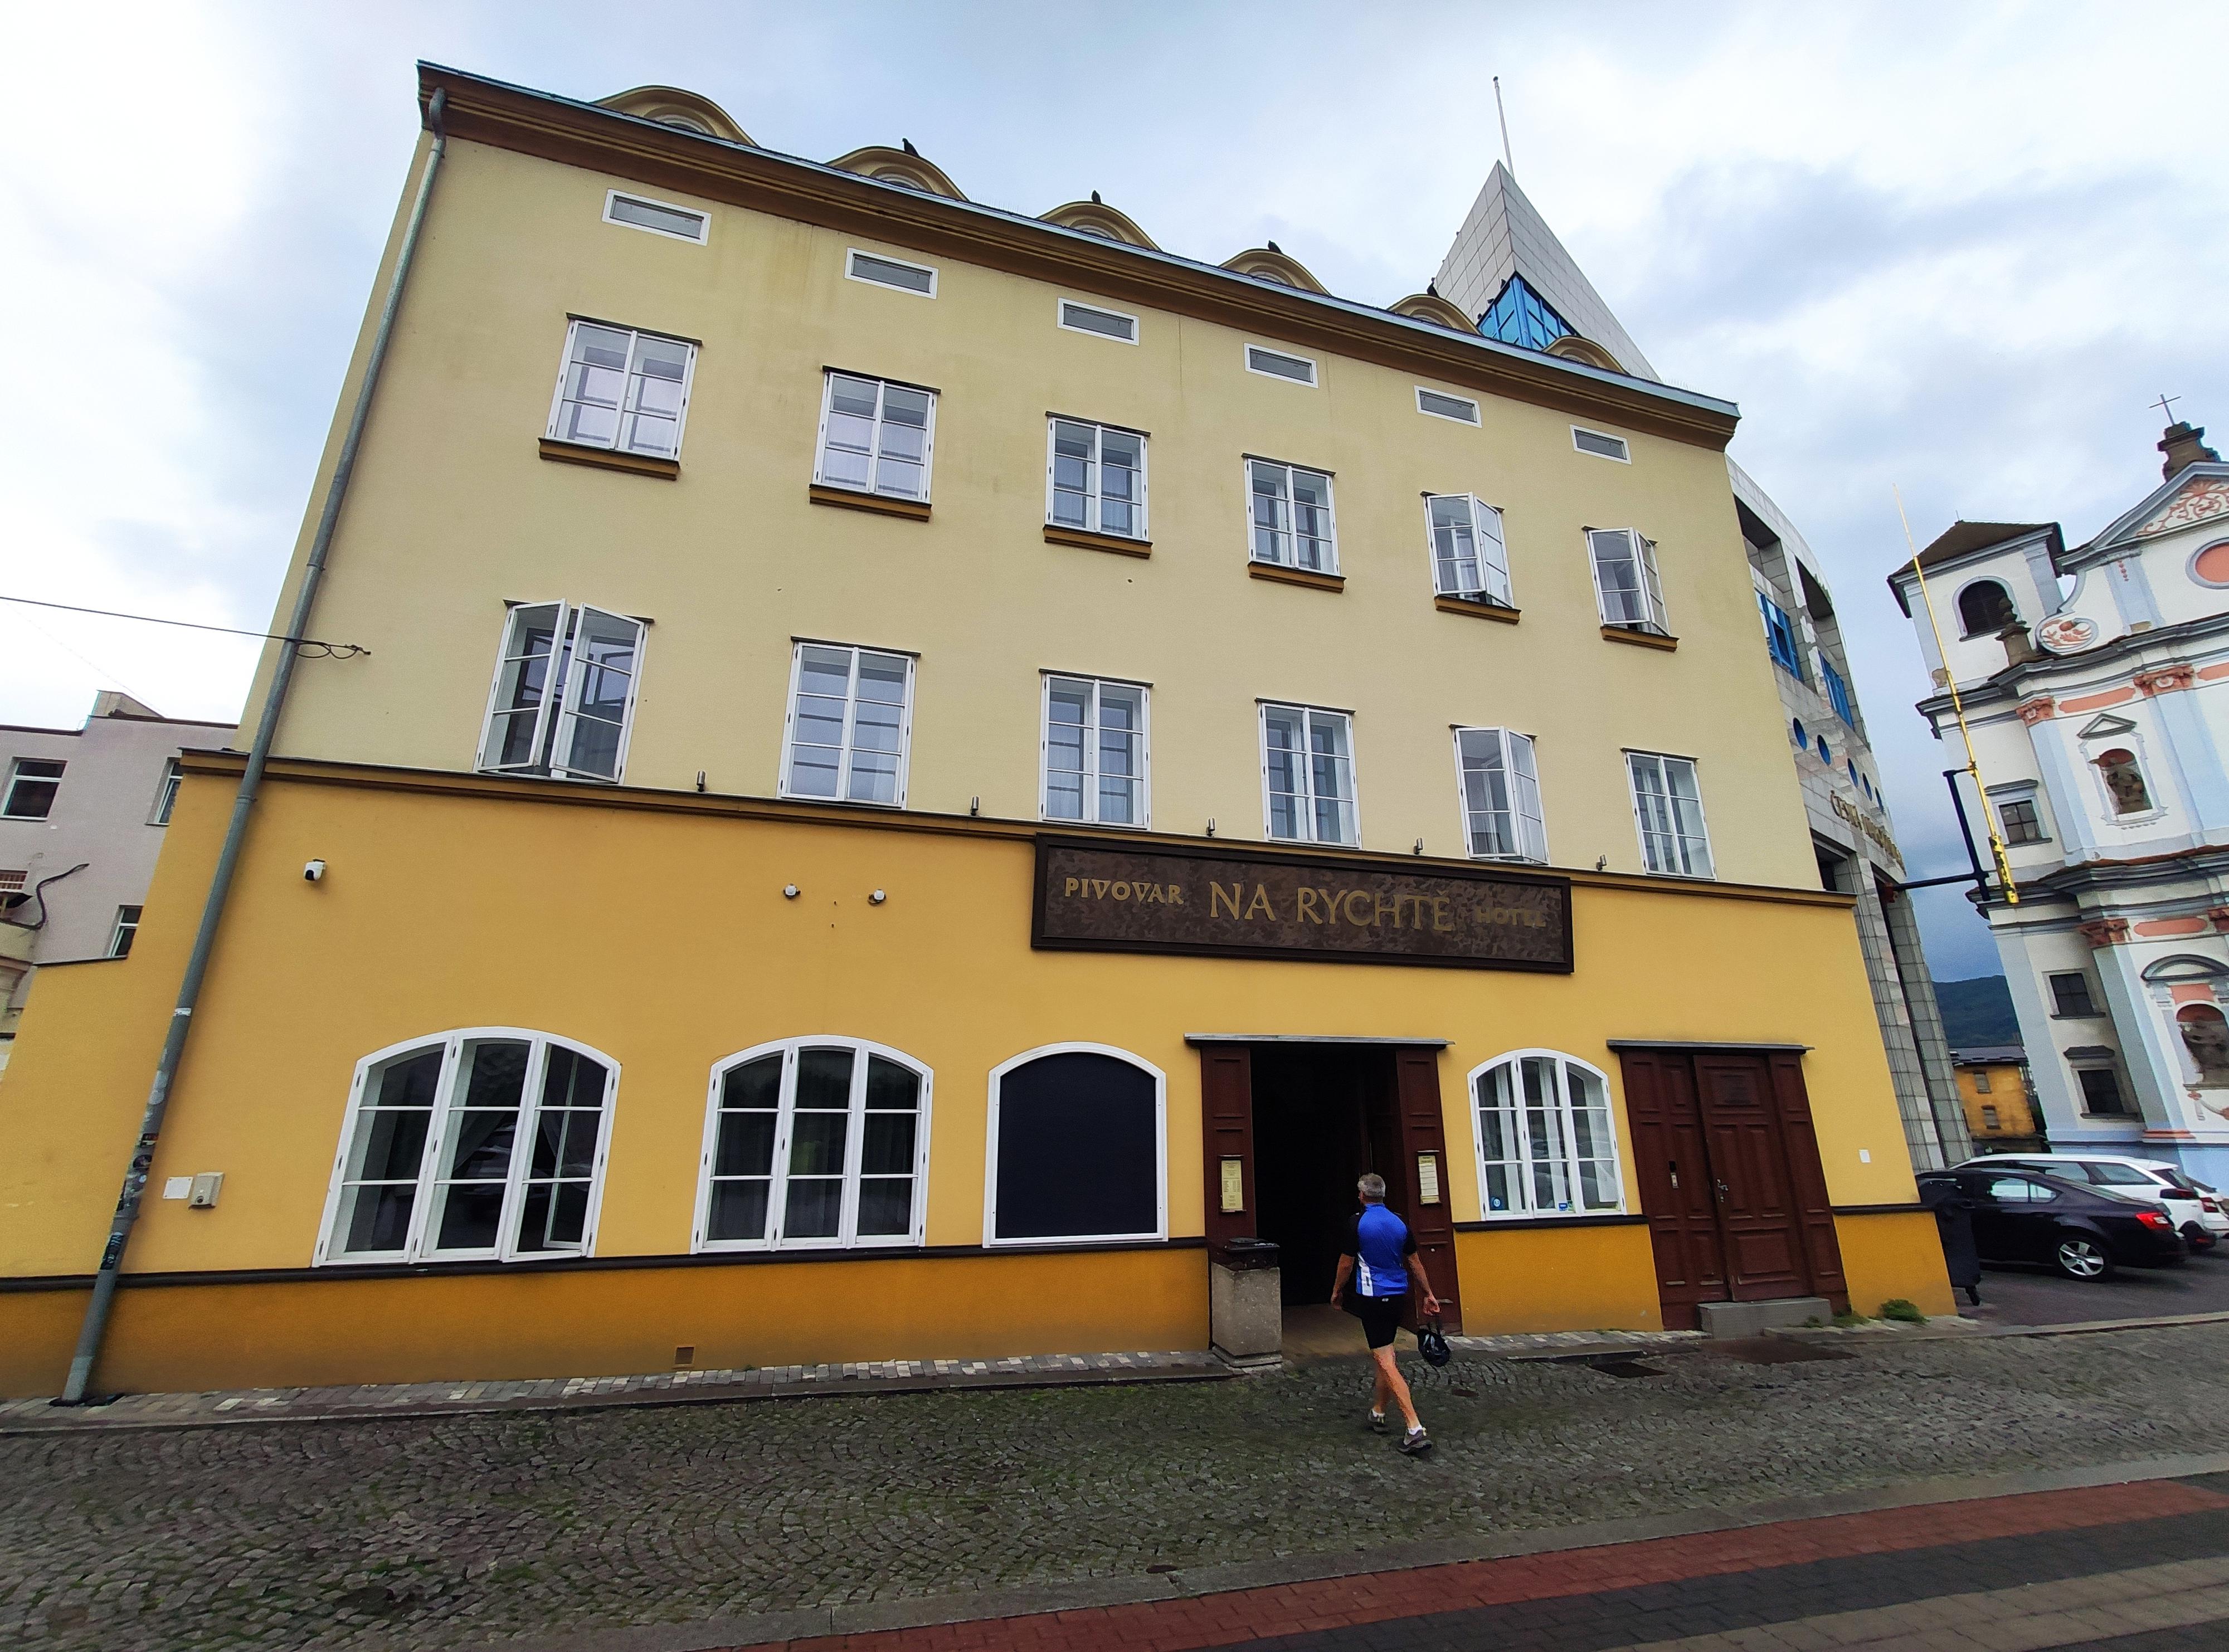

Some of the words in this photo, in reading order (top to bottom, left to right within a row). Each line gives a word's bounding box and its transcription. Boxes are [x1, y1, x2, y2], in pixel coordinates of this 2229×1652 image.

[1064, 877, 1185, 905] PIVOVAR
[1209, 881, 1277, 922] NA
[1296, 887, 1455, 932] RYCHTĚ
[1477, 905, 1547, 928] HOTEL
